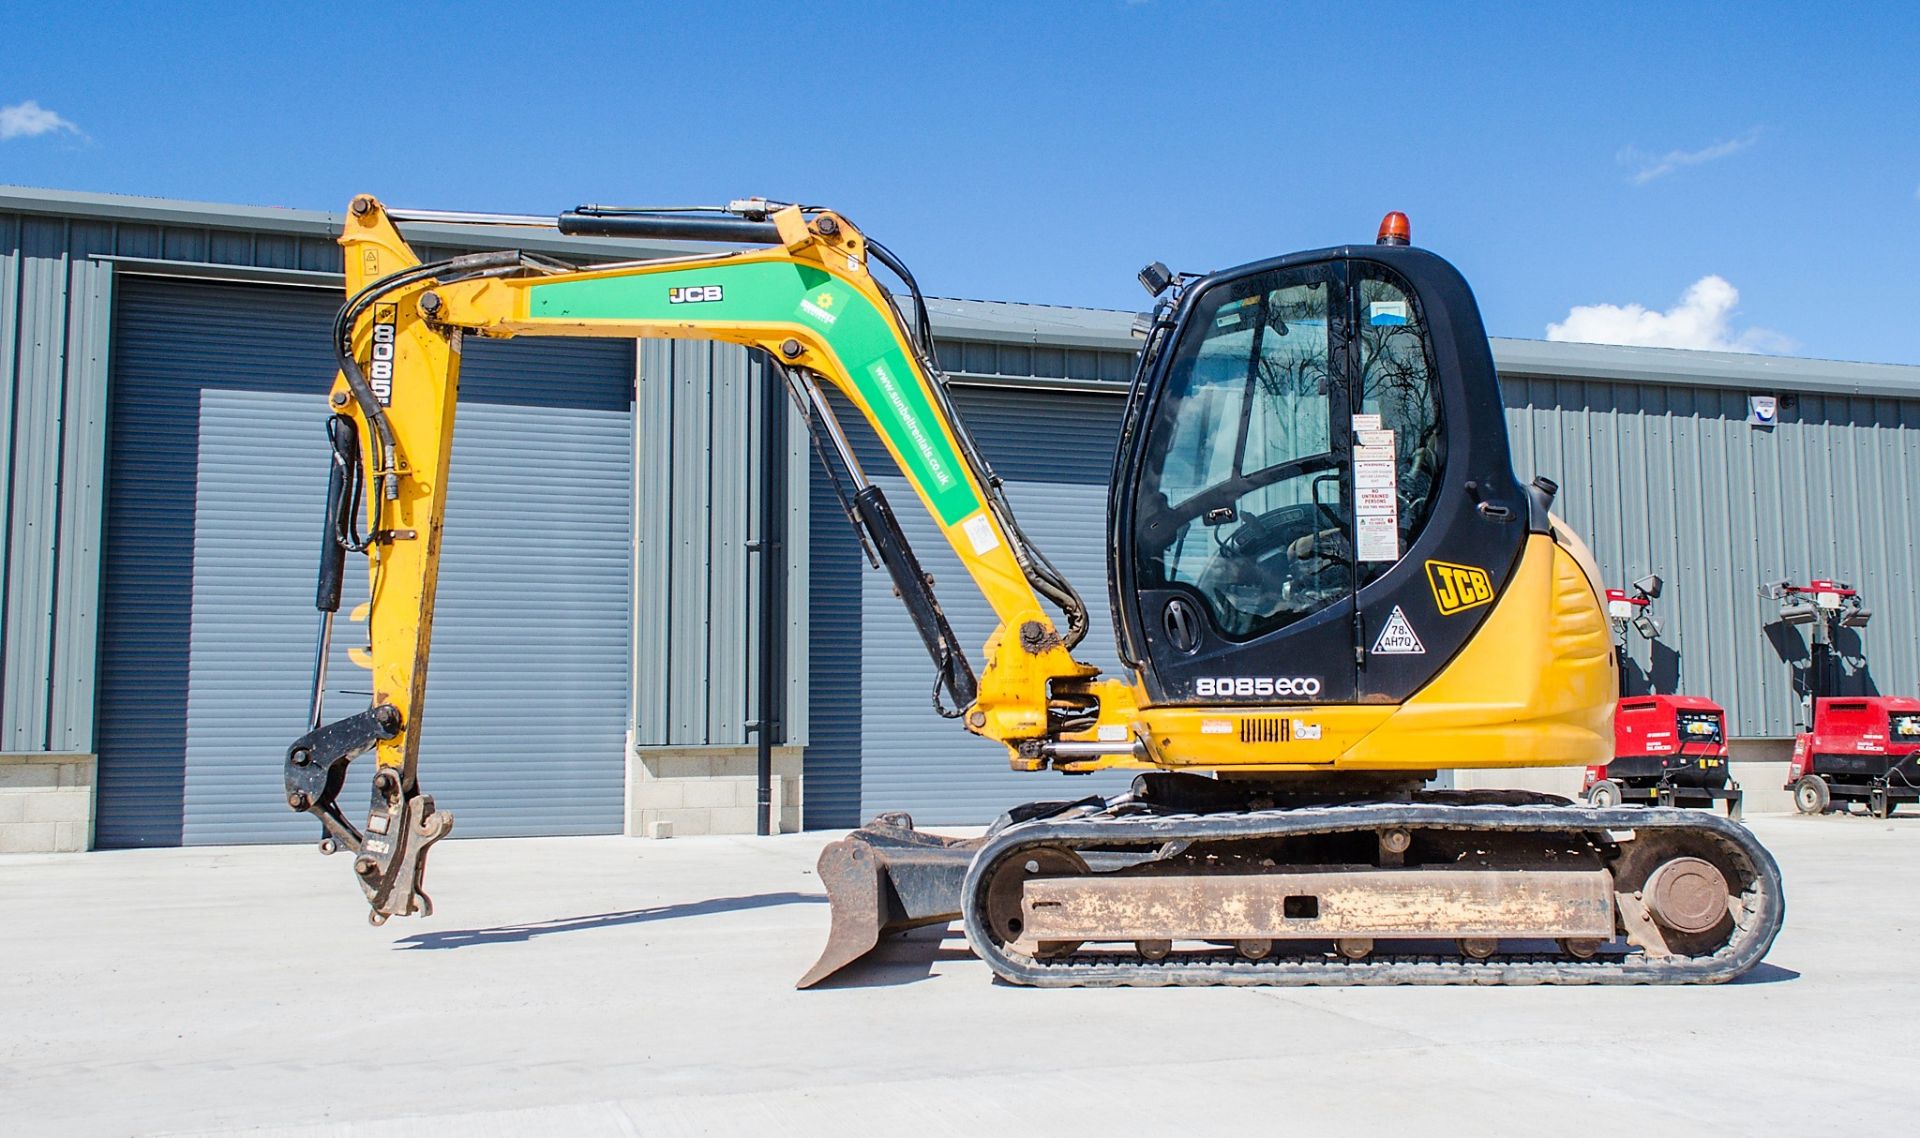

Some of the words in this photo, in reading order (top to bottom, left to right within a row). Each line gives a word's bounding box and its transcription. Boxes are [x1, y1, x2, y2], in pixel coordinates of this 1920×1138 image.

[670, 287, 722, 303] JCB
[371, 325, 395, 397] 8085
[875, 366, 950, 486] www.sunbeltrentals.co.uk
[1437, 566, 1489, 608] JCB
